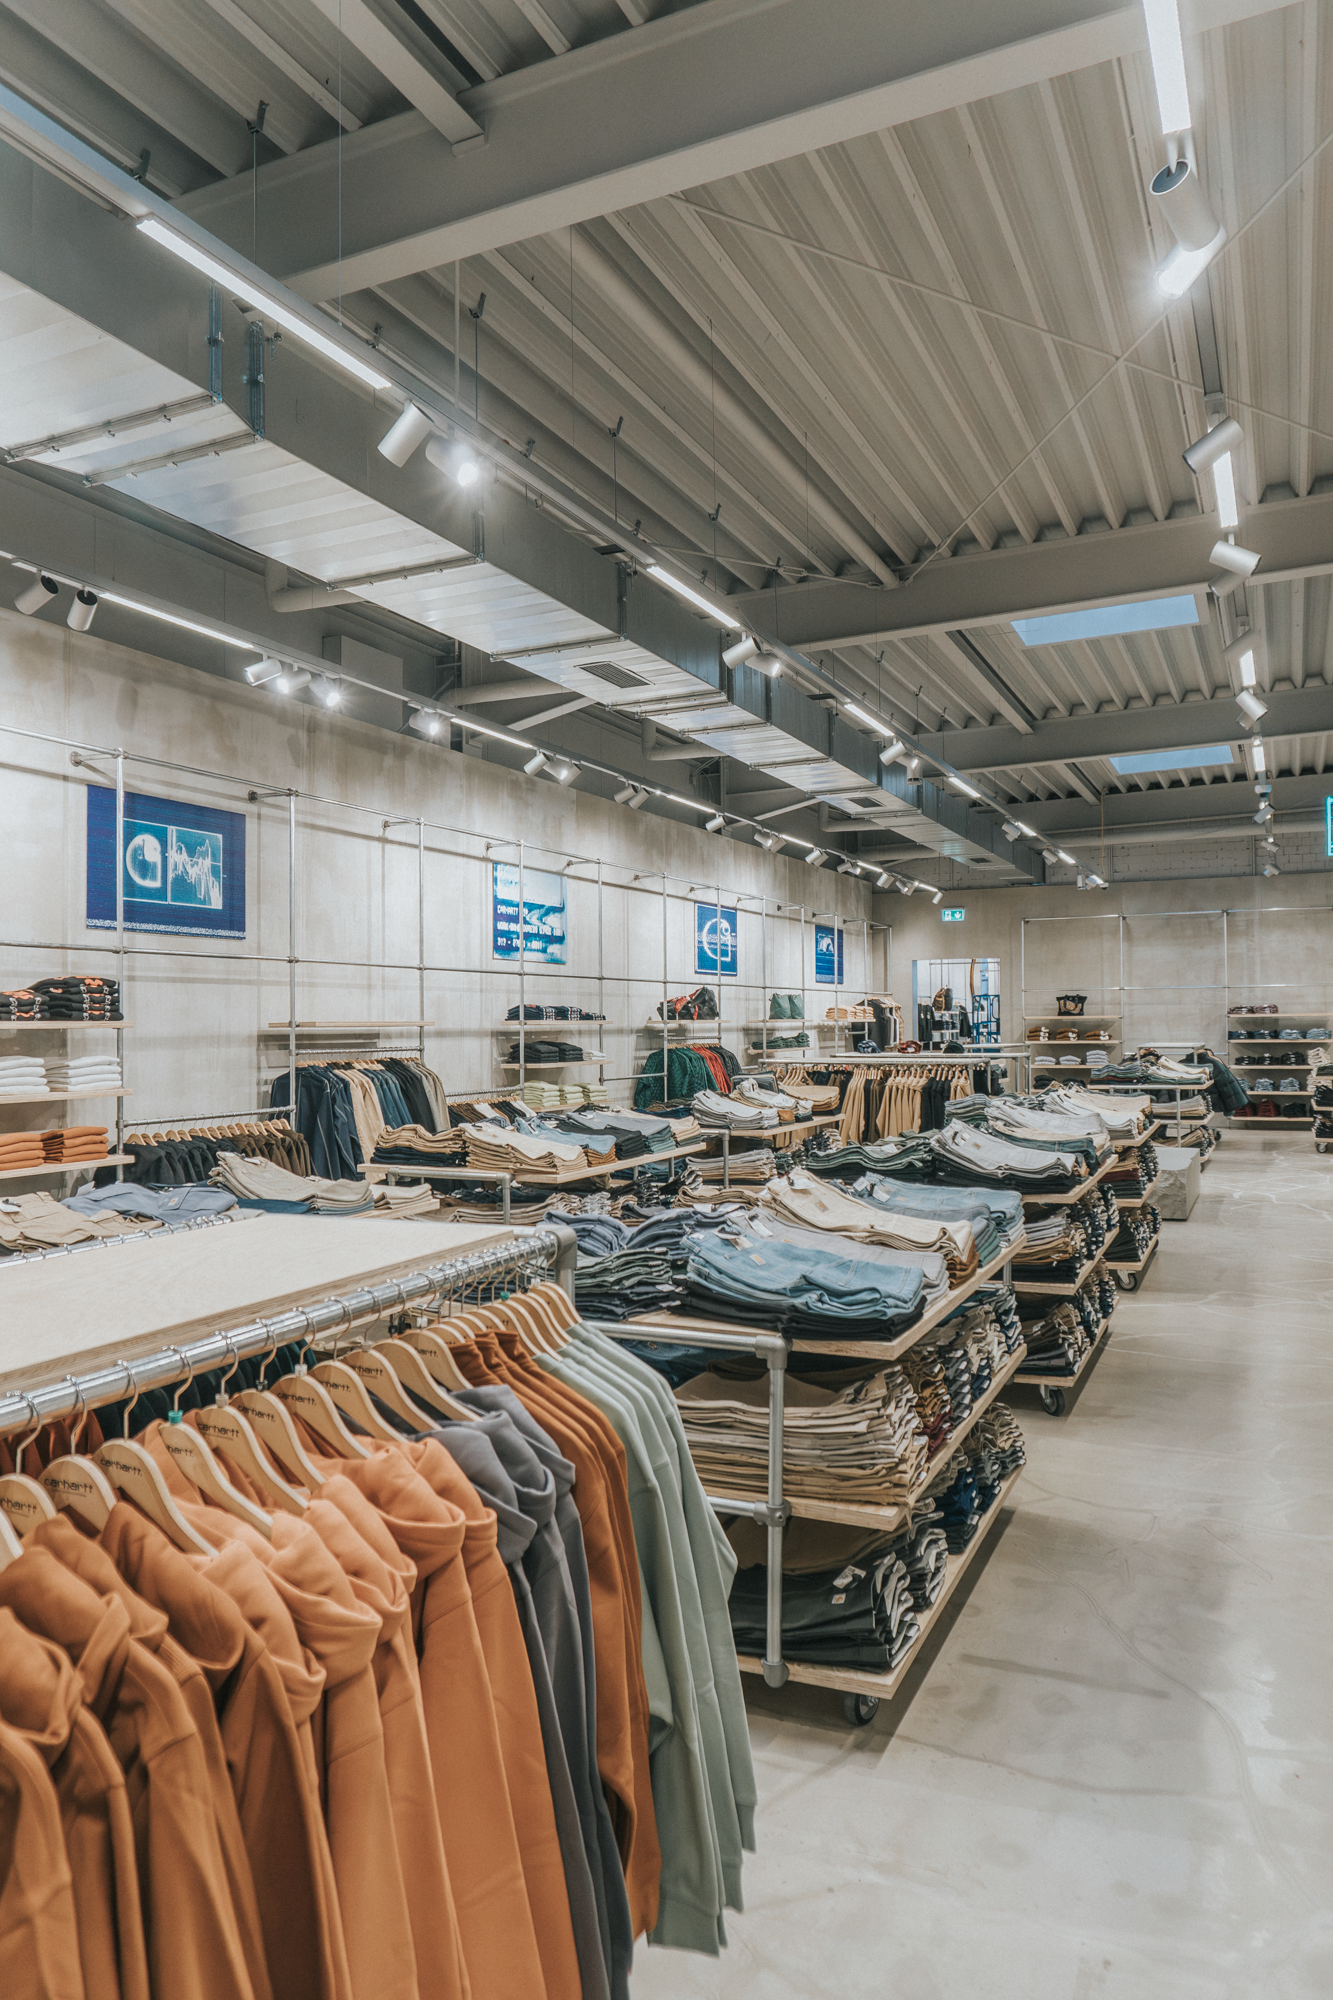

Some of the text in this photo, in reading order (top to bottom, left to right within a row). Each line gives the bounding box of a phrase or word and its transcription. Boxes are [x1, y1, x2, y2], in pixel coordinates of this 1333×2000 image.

[197, 1422, 240, 1438] carhartt
[43, 1477, 94, 1494] carhartt
[0, 1496, 37, 1514] rhartt
